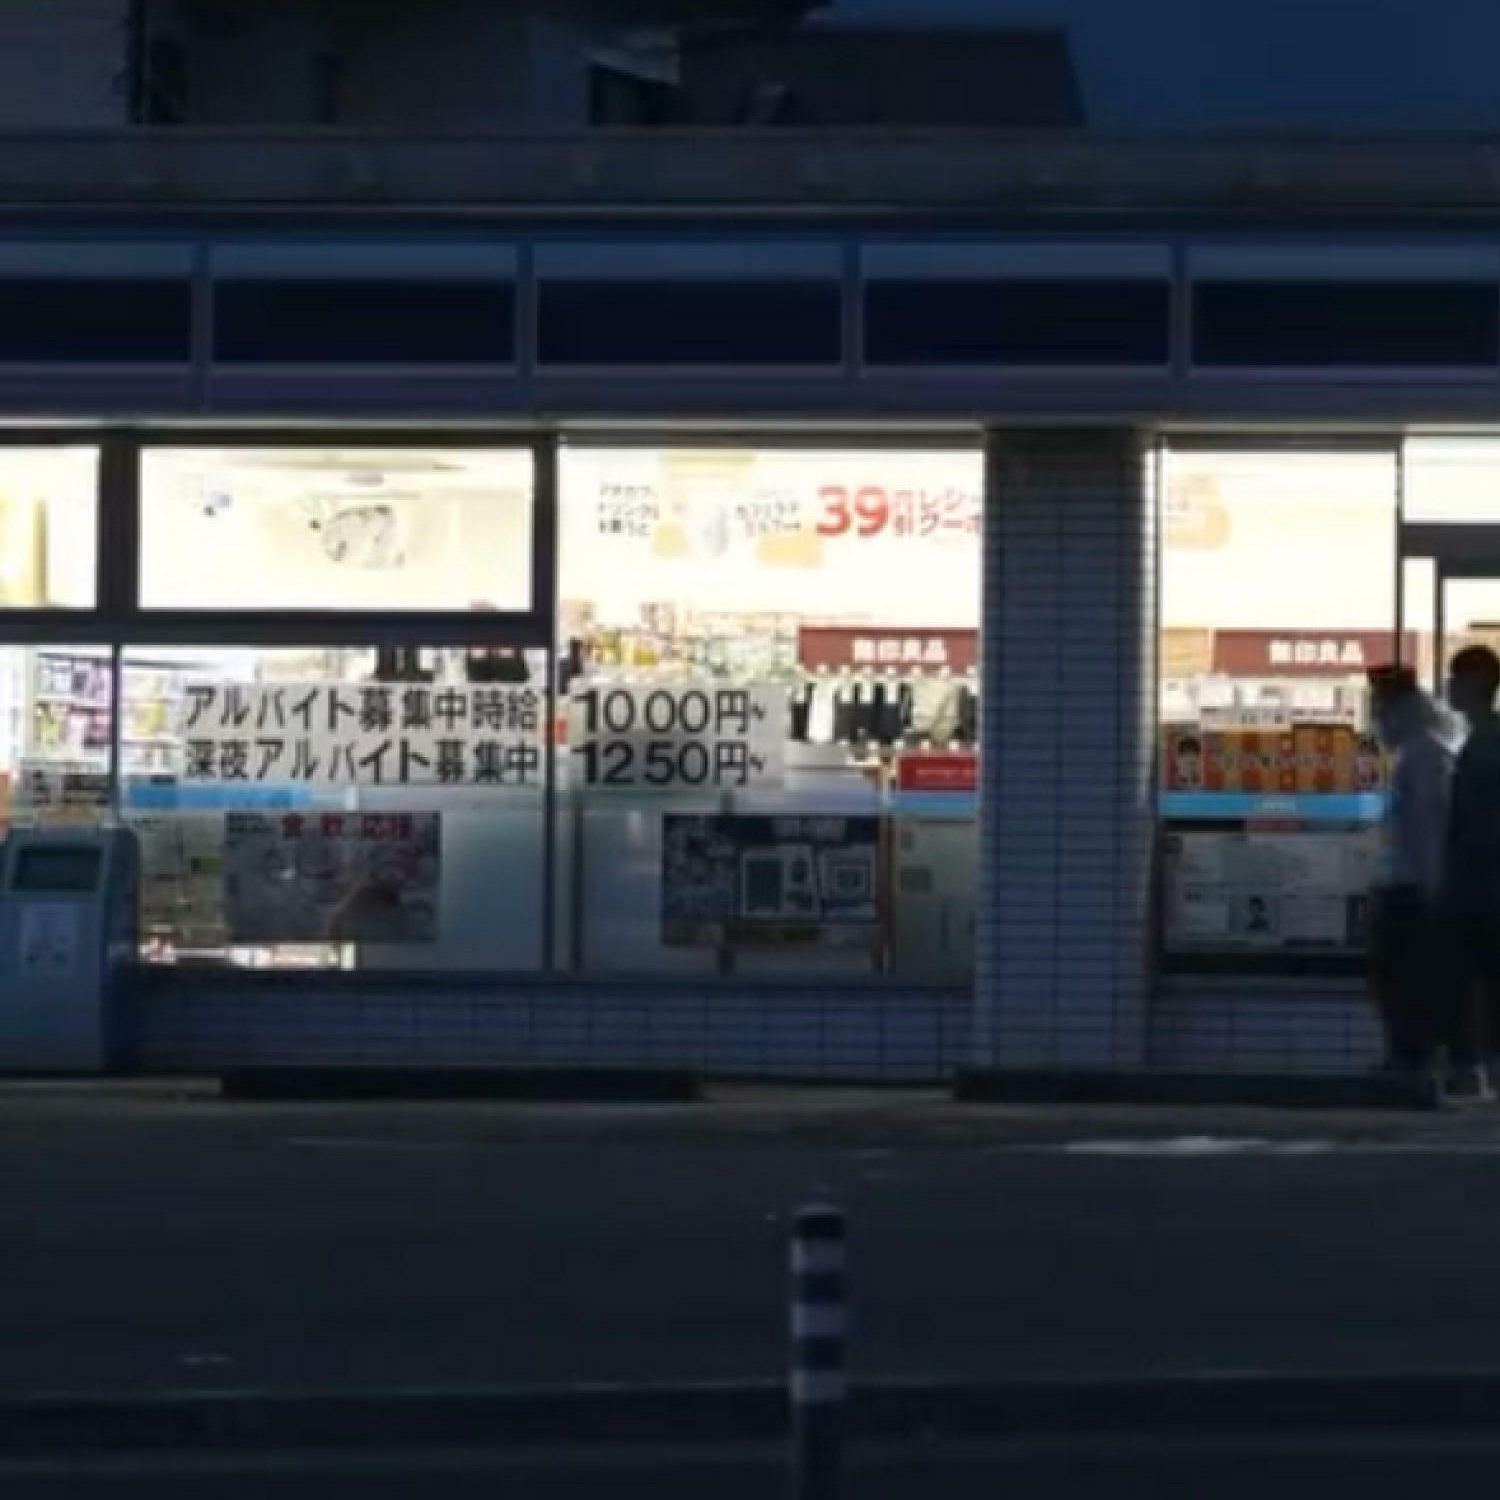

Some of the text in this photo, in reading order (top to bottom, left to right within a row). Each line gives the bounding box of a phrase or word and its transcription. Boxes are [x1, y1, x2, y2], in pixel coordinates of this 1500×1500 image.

[816, 485, 889, 537] 39
[184, 685, 538, 731] アルバイト募集中時給
[185, 738, 538, 784] 深夜アルバイト募集中
